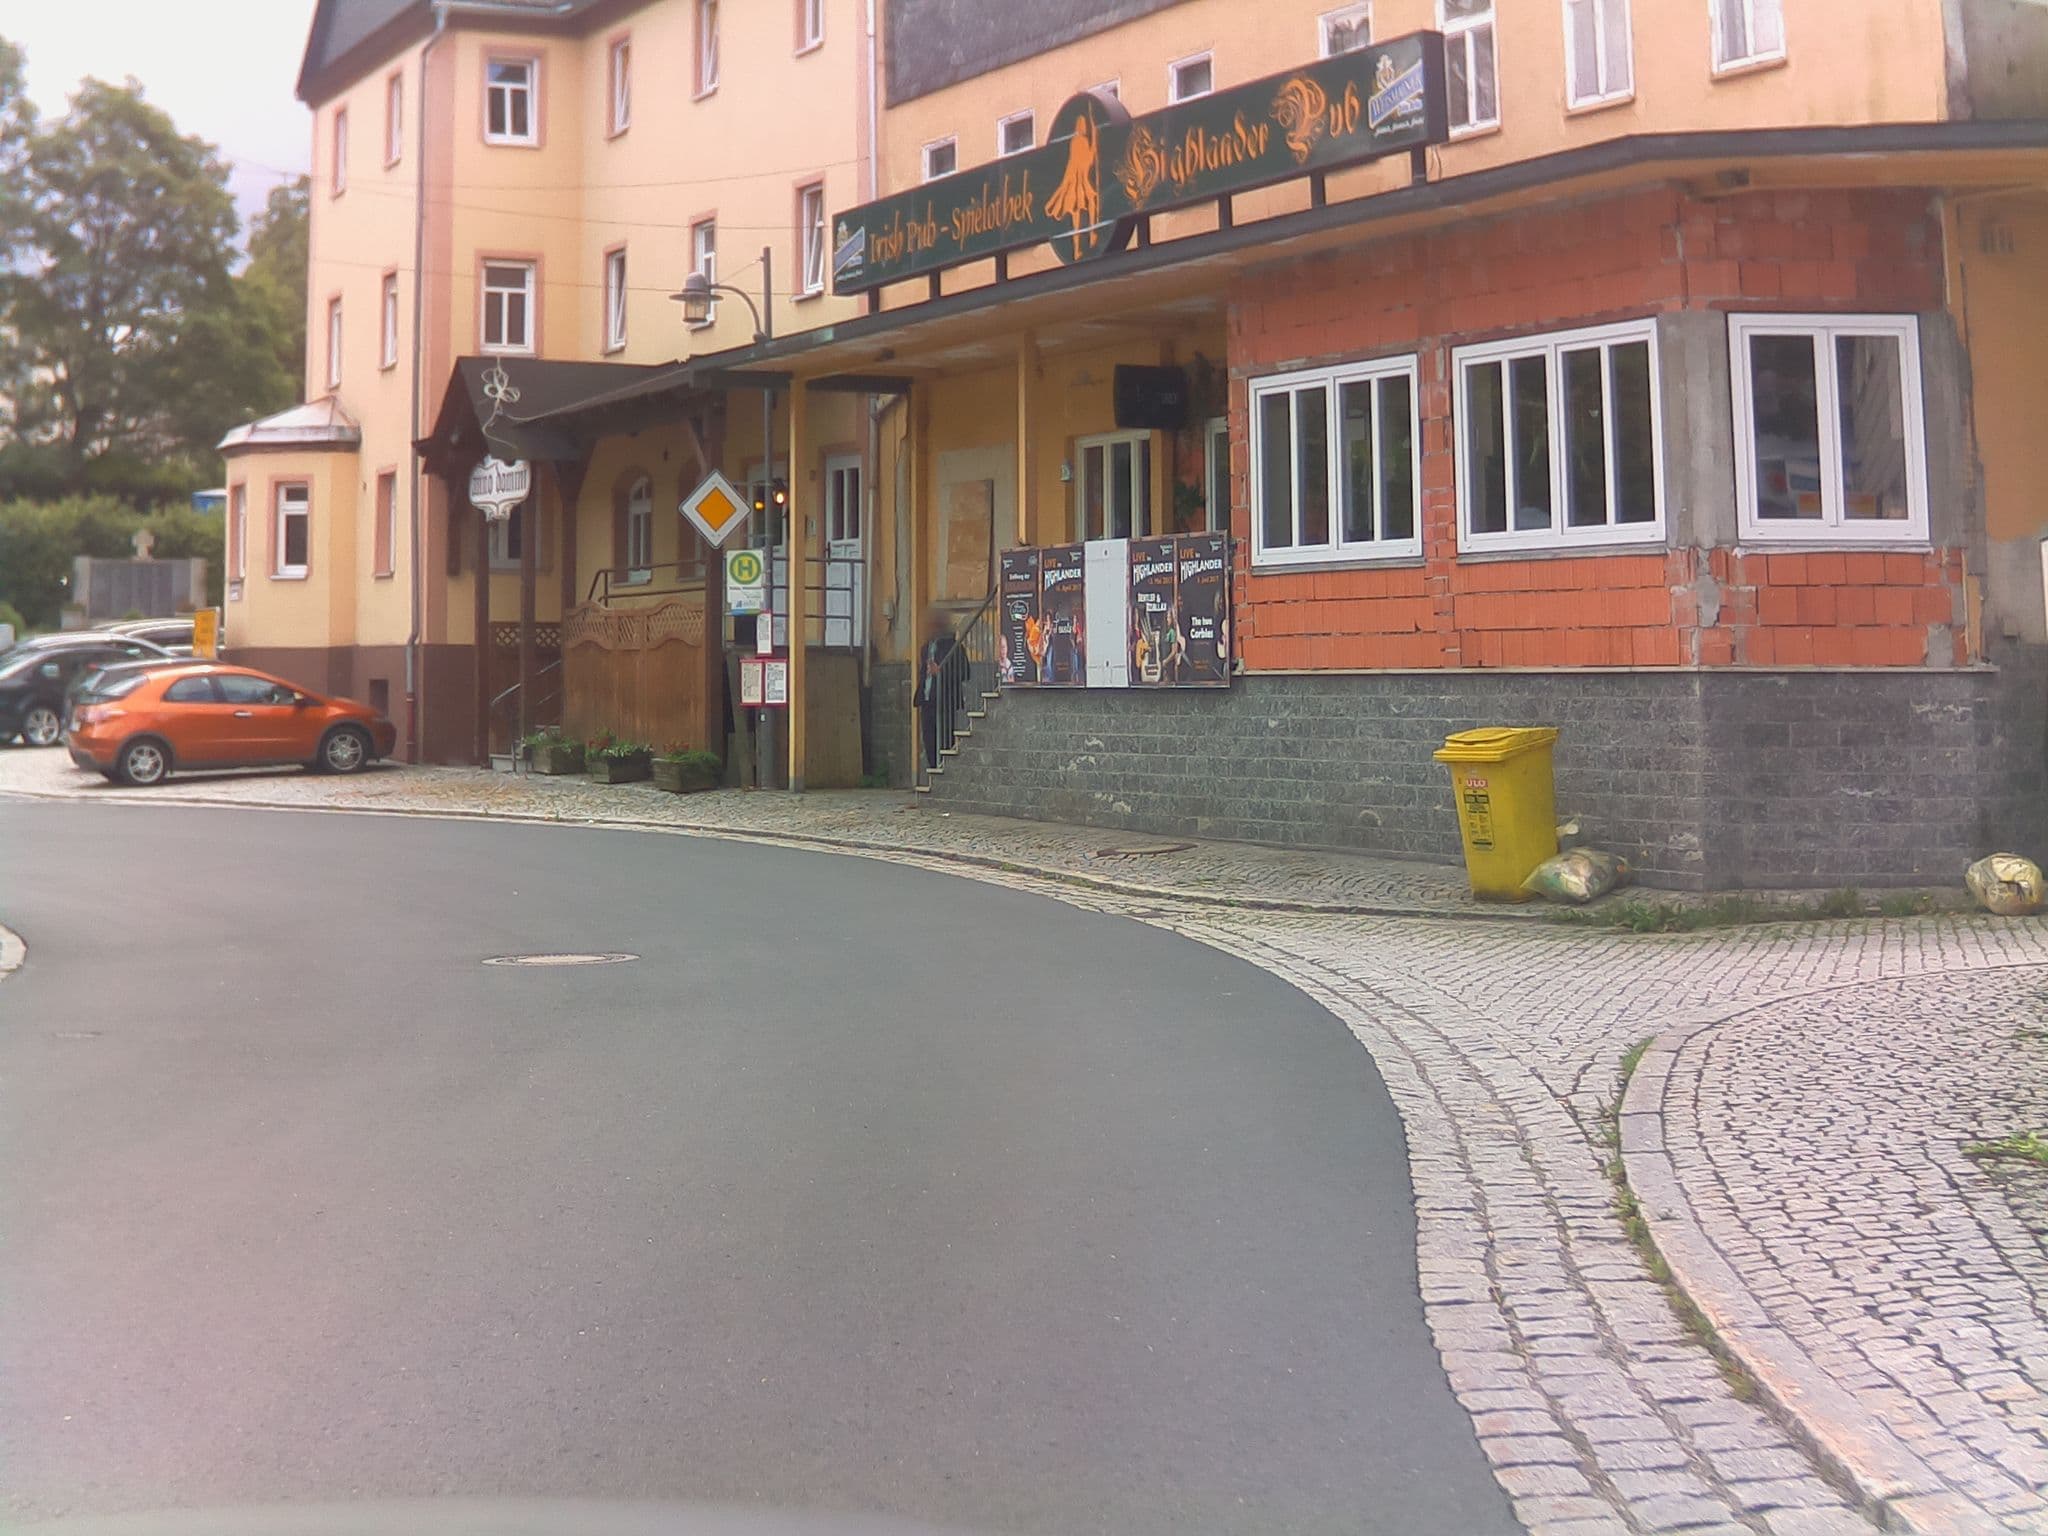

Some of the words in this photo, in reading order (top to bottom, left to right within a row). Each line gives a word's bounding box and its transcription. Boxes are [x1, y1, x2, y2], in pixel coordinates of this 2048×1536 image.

[1271, 74, 1360, 164] Pub
[870, 211, 904, 264] Irish
[906, 200, 937, 252] Pub
[952, 174, 1034, 250] Spielothek
[1133, 552, 1146, 563] LIVE
[1181, 548, 1195, 559] LIVE
[738, 559, 752, 577] H
[1044, 568, 1082, 591] HIGHLANDER
[1133, 562, 1173, 586] HIGHLANDER
[1181, 559, 1222, 583] HIGHLANDER
